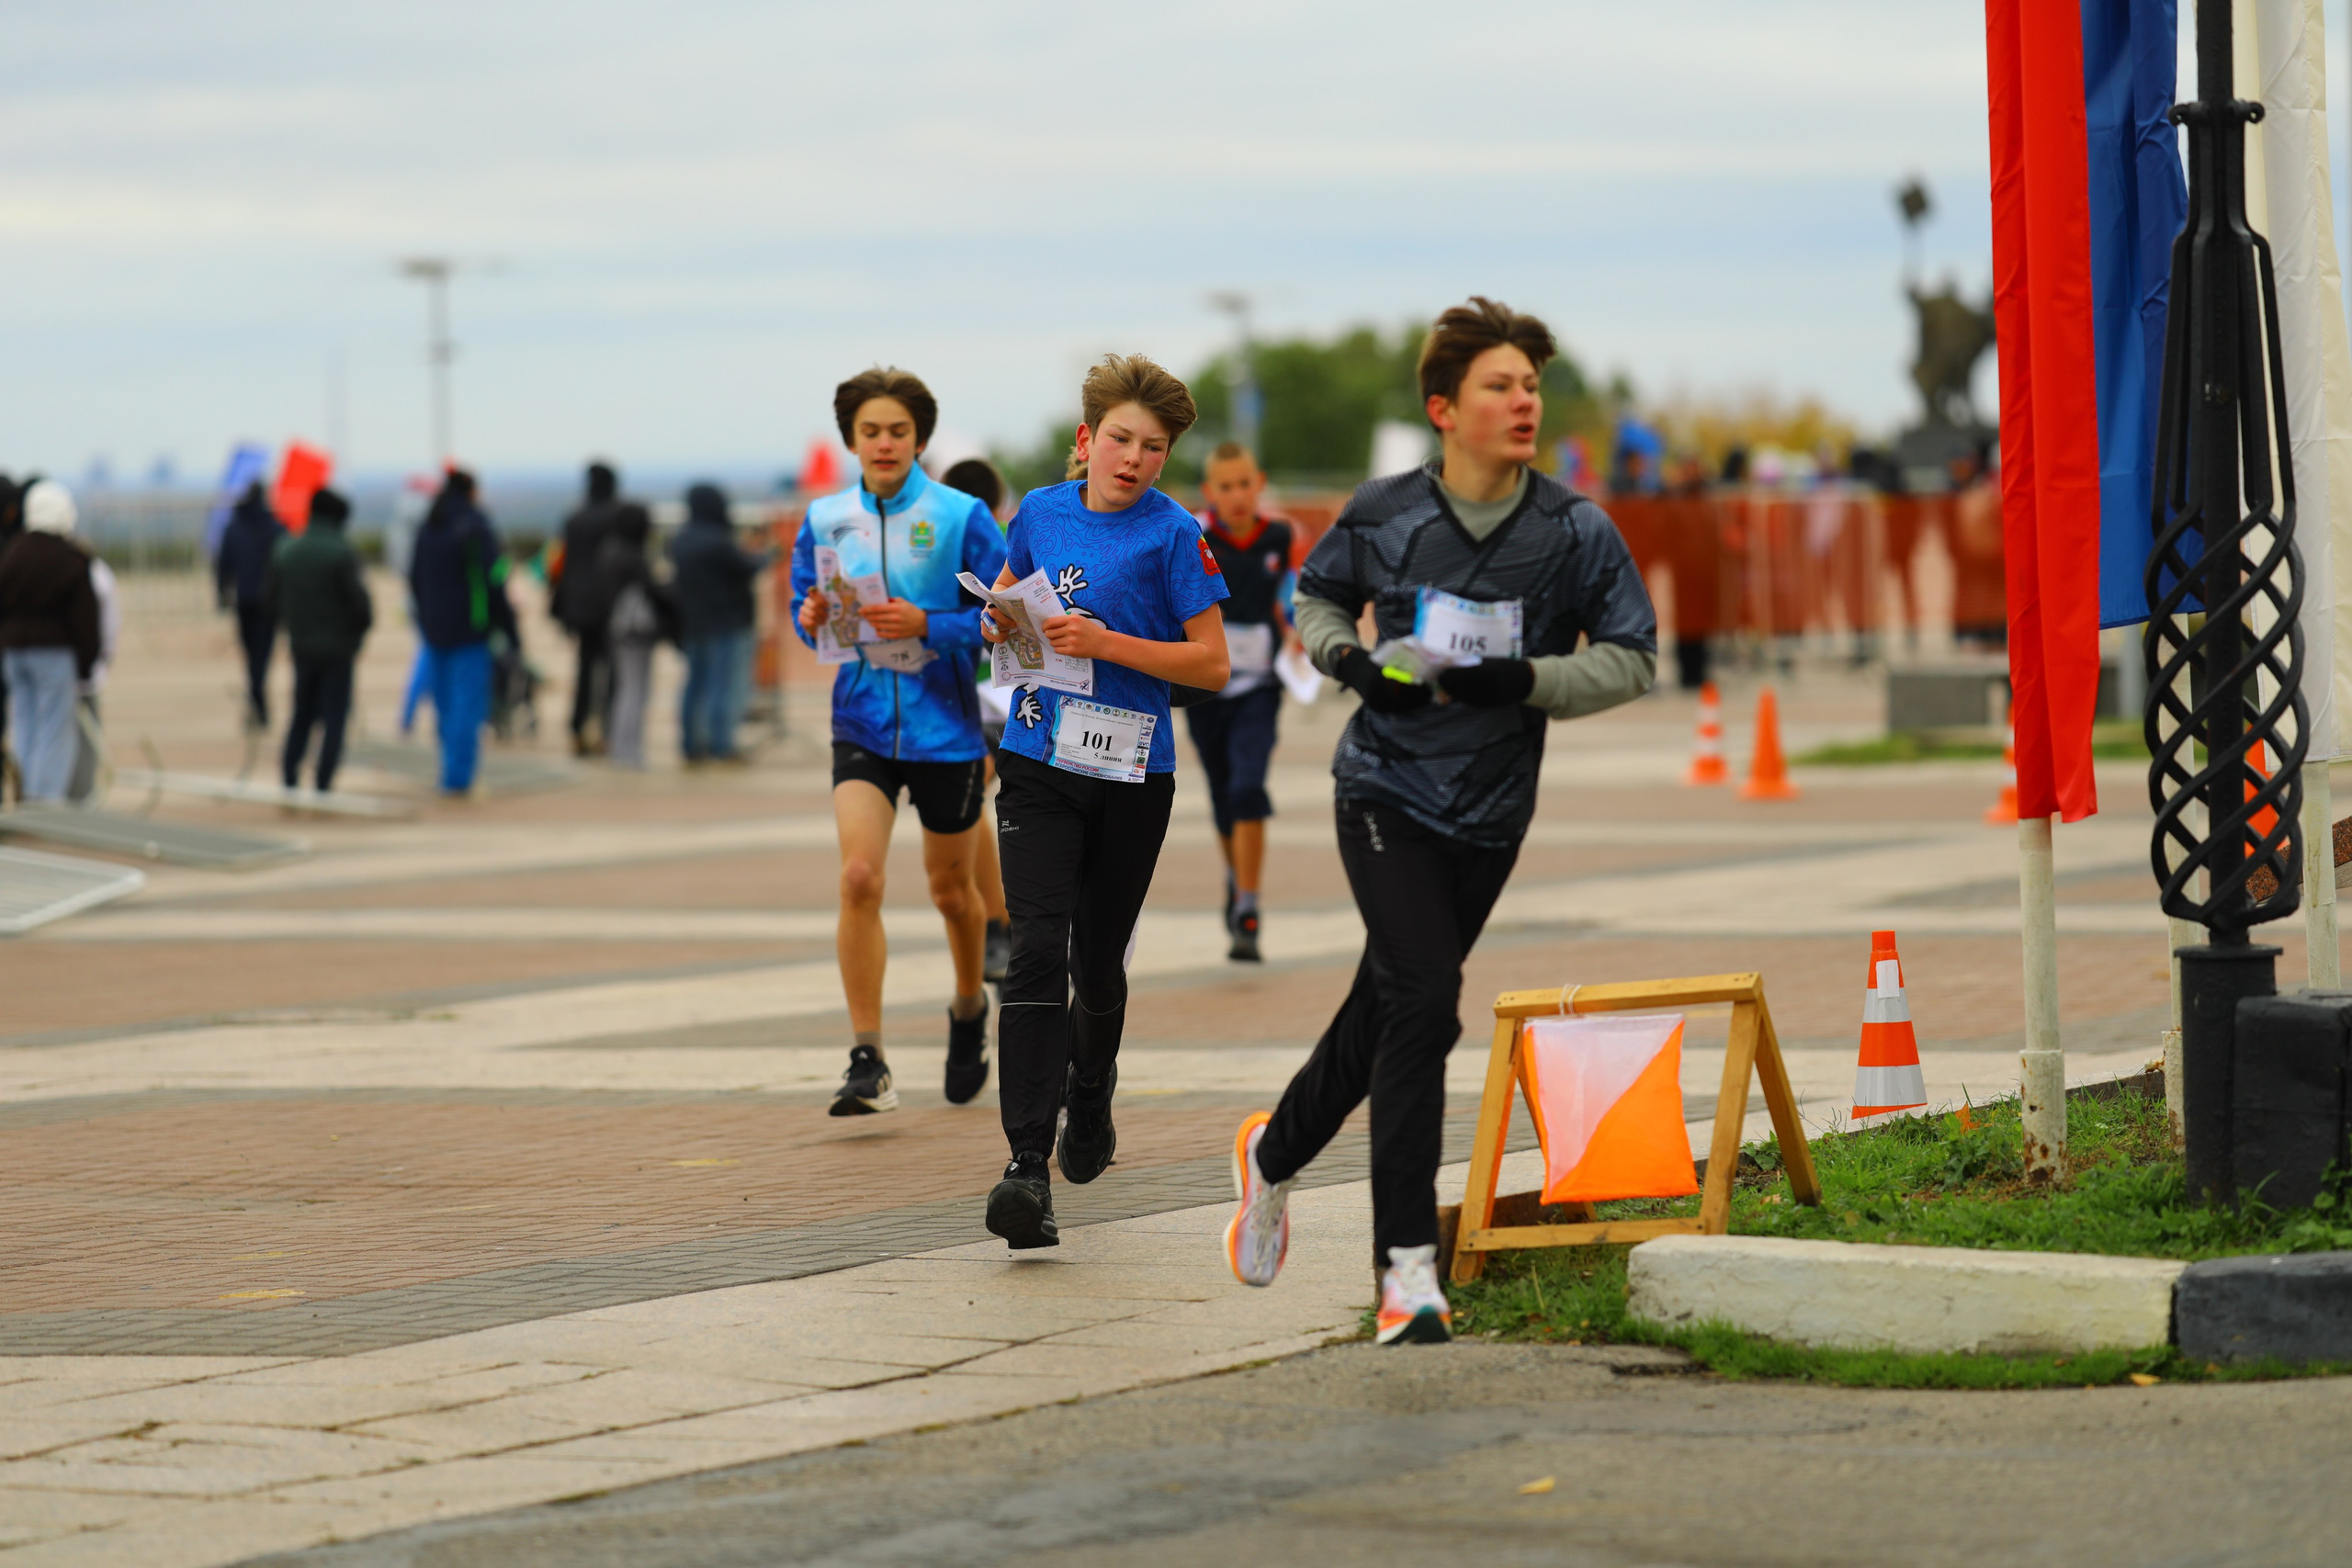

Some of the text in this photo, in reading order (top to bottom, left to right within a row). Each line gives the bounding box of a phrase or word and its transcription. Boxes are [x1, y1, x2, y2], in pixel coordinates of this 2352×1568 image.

[1449, 632, 1488, 654] 105
[1081, 730, 1113, 751] 101
[1056, 758, 1100, 773] ПЕРВЕНСТВО РОССИИ
[1100, 754, 1123, 763] линия
[1089, 770, 1123, 781] СОРЕВНОВАНИЯ
